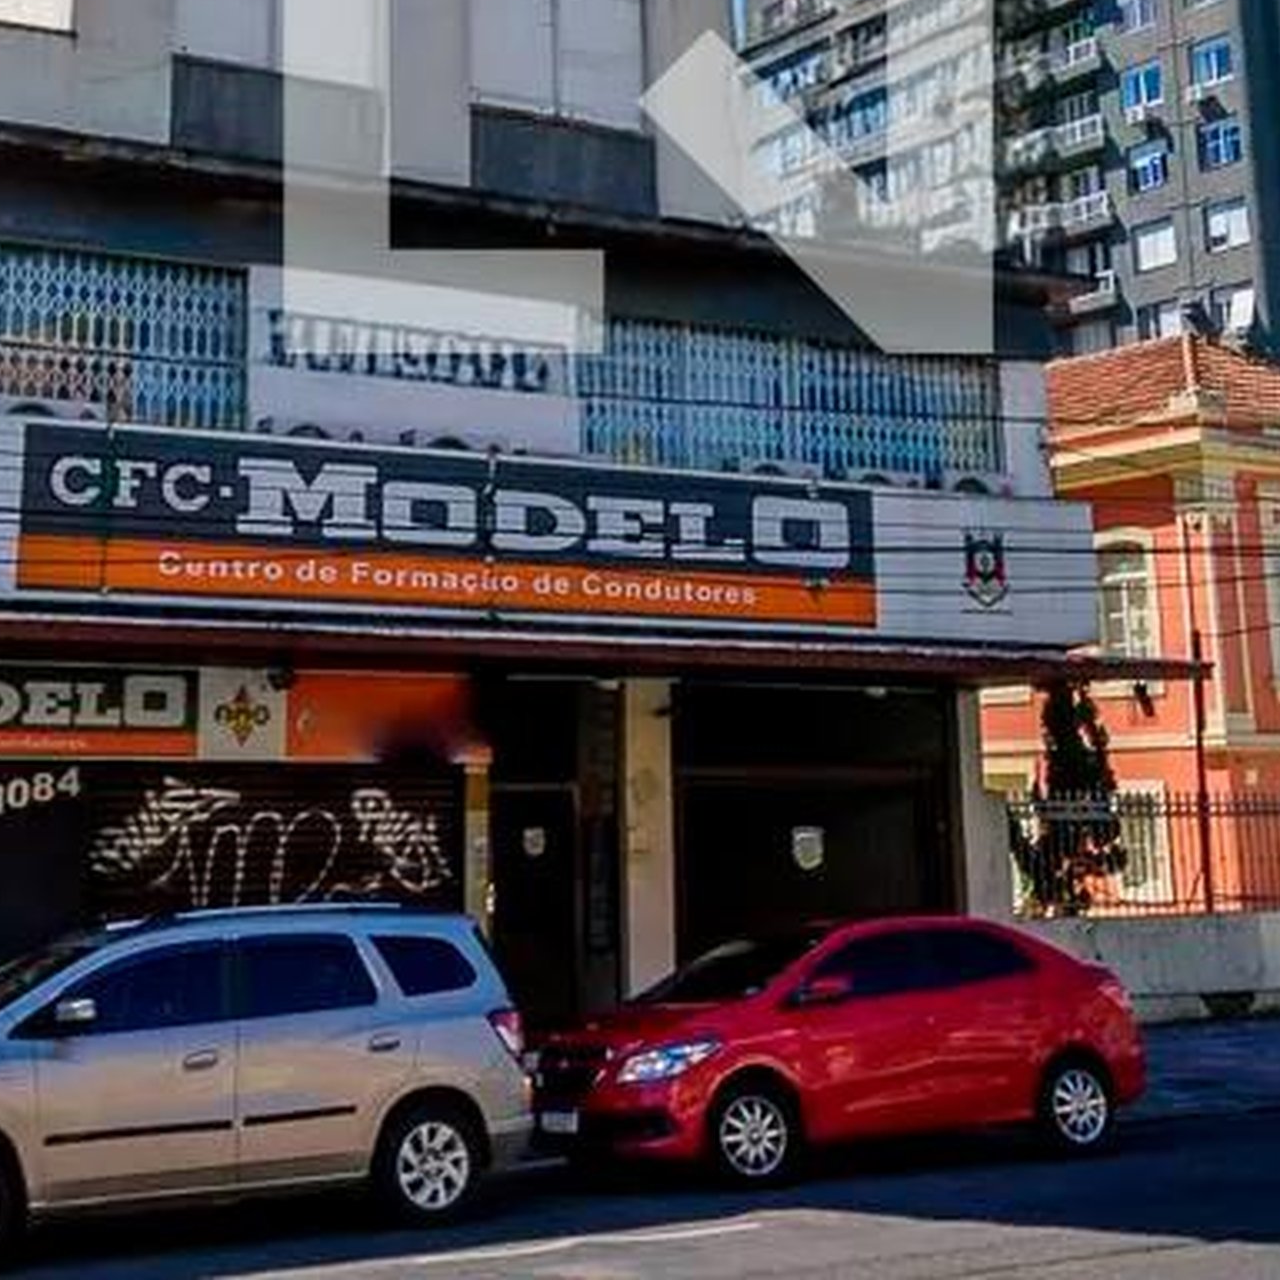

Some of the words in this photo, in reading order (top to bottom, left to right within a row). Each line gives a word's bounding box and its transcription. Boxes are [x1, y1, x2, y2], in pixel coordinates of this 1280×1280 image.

[158, 551, 283, 581] Centro
[295, 560, 339, 583] de
[532, 573, 571, 596] de
[581, 574, 756, 605] Condutores
